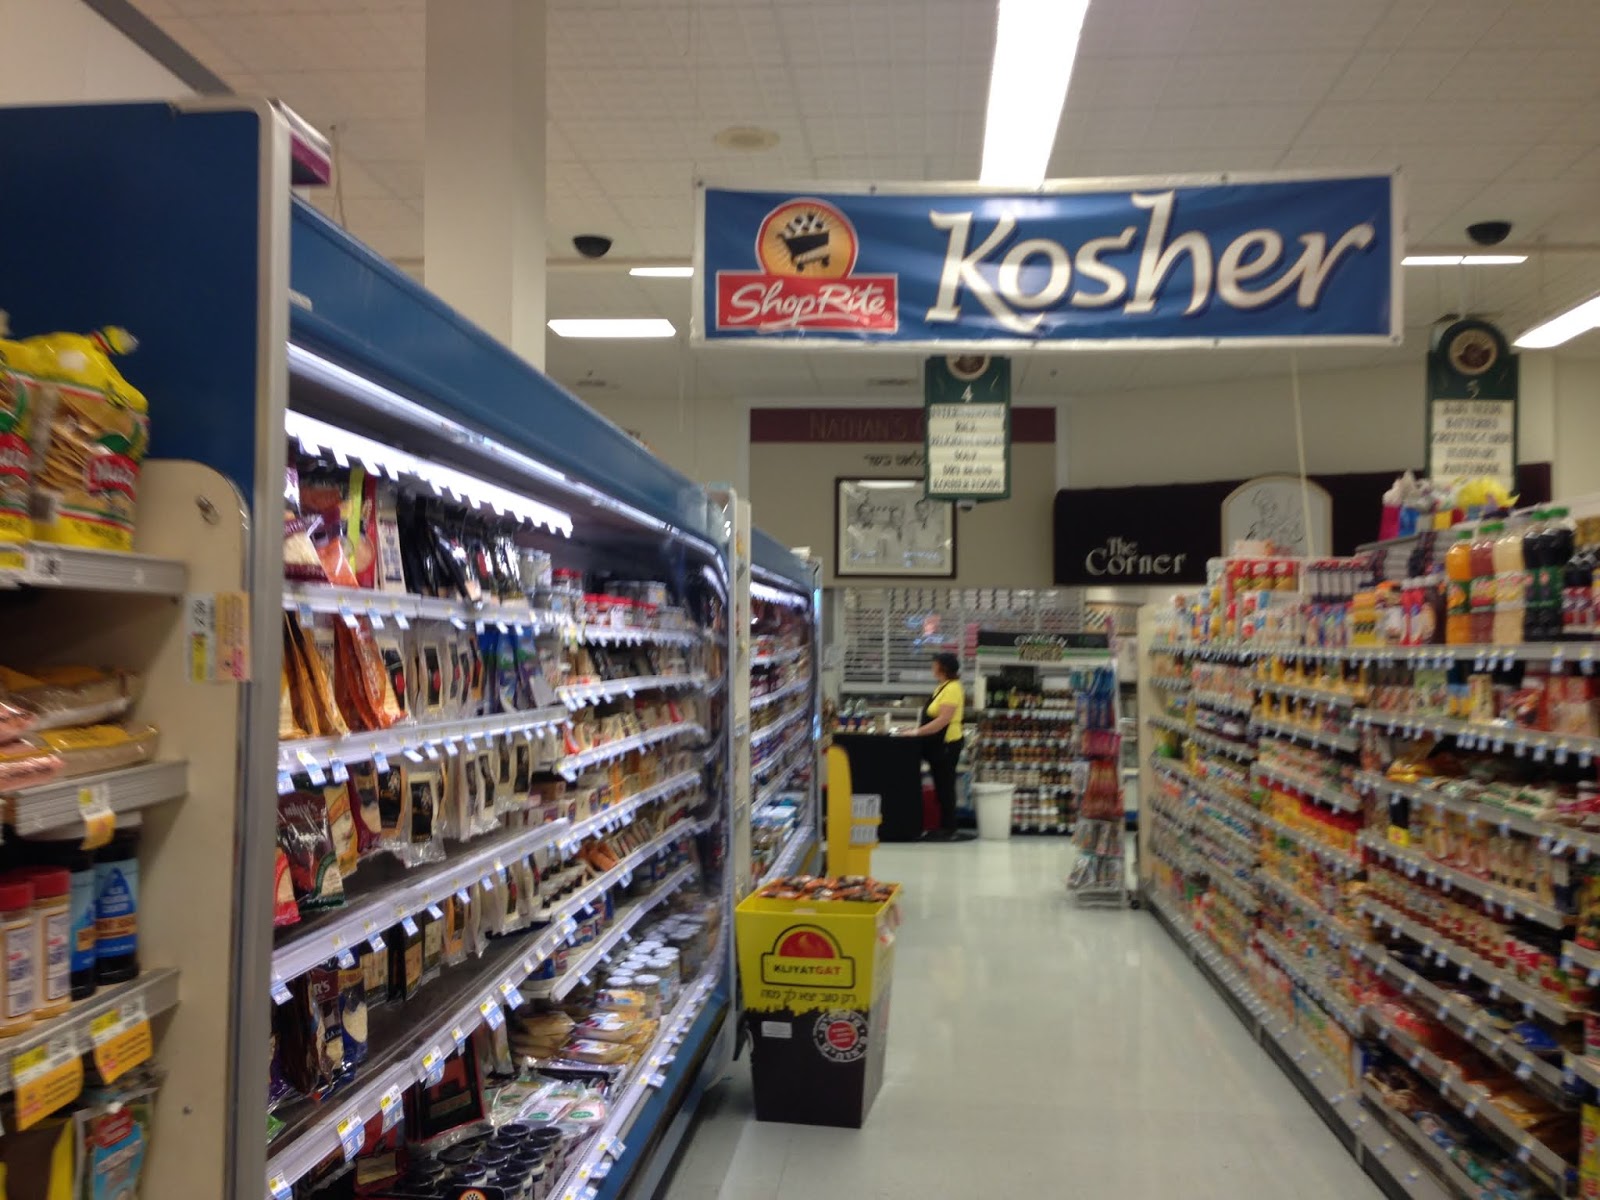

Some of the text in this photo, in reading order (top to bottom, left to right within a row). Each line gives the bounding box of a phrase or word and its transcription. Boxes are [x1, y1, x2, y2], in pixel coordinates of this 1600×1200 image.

[924, 190, 1376, 334] Kosher
[727, 279, 888, 331] ShopRite
[960, 384, 975, 403] 4
[1106, 536, 1138, 557] The
[1085, 547, 1187, 576] Corner
[773, 963, 843, 976] KLIYATGAT
